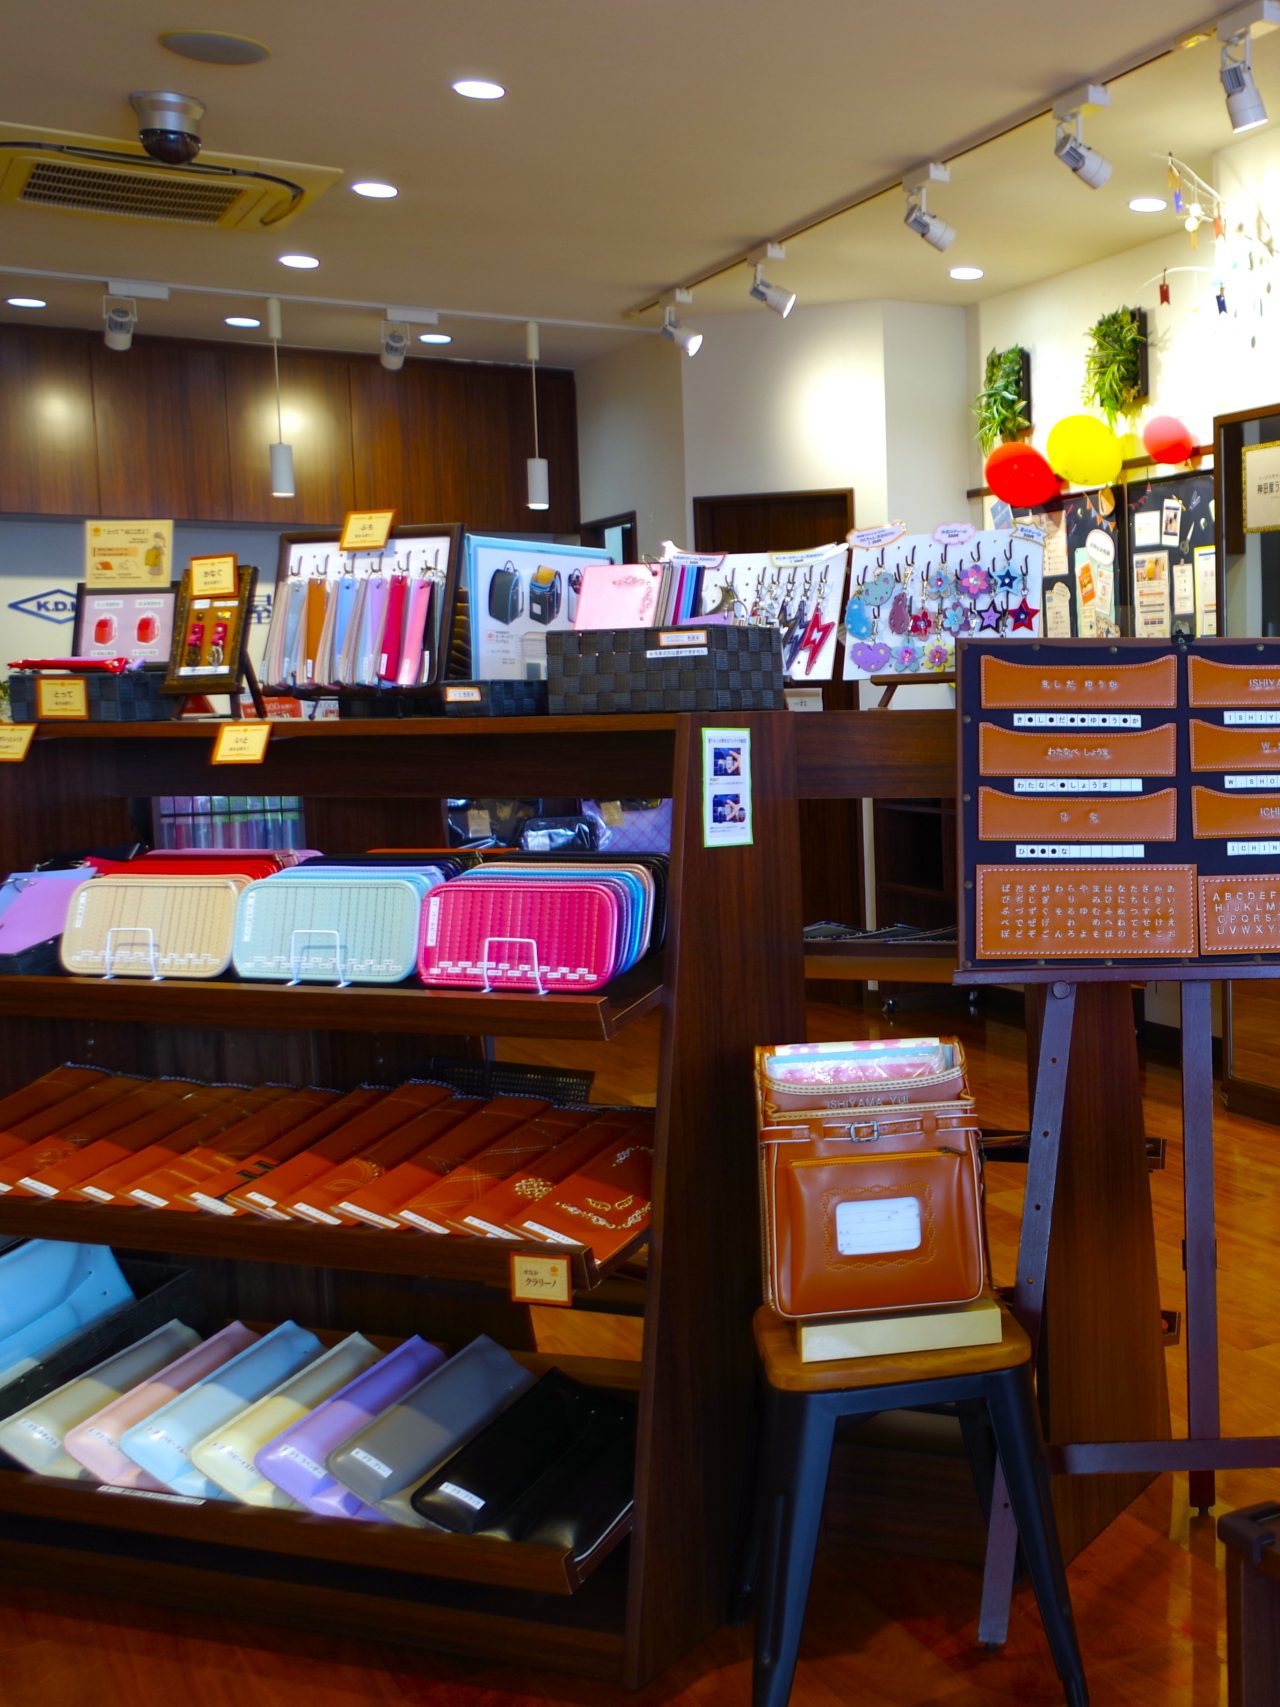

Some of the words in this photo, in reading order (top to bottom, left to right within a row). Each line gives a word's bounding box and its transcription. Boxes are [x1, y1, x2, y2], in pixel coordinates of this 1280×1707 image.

[36, 601, 77, 612] K.D.
[827, 1098, 882, 1109] ISHIYAMA
[890, 1095, 909, 1105] YUI
[525, 1277, 557, 1287] クラリーノ
